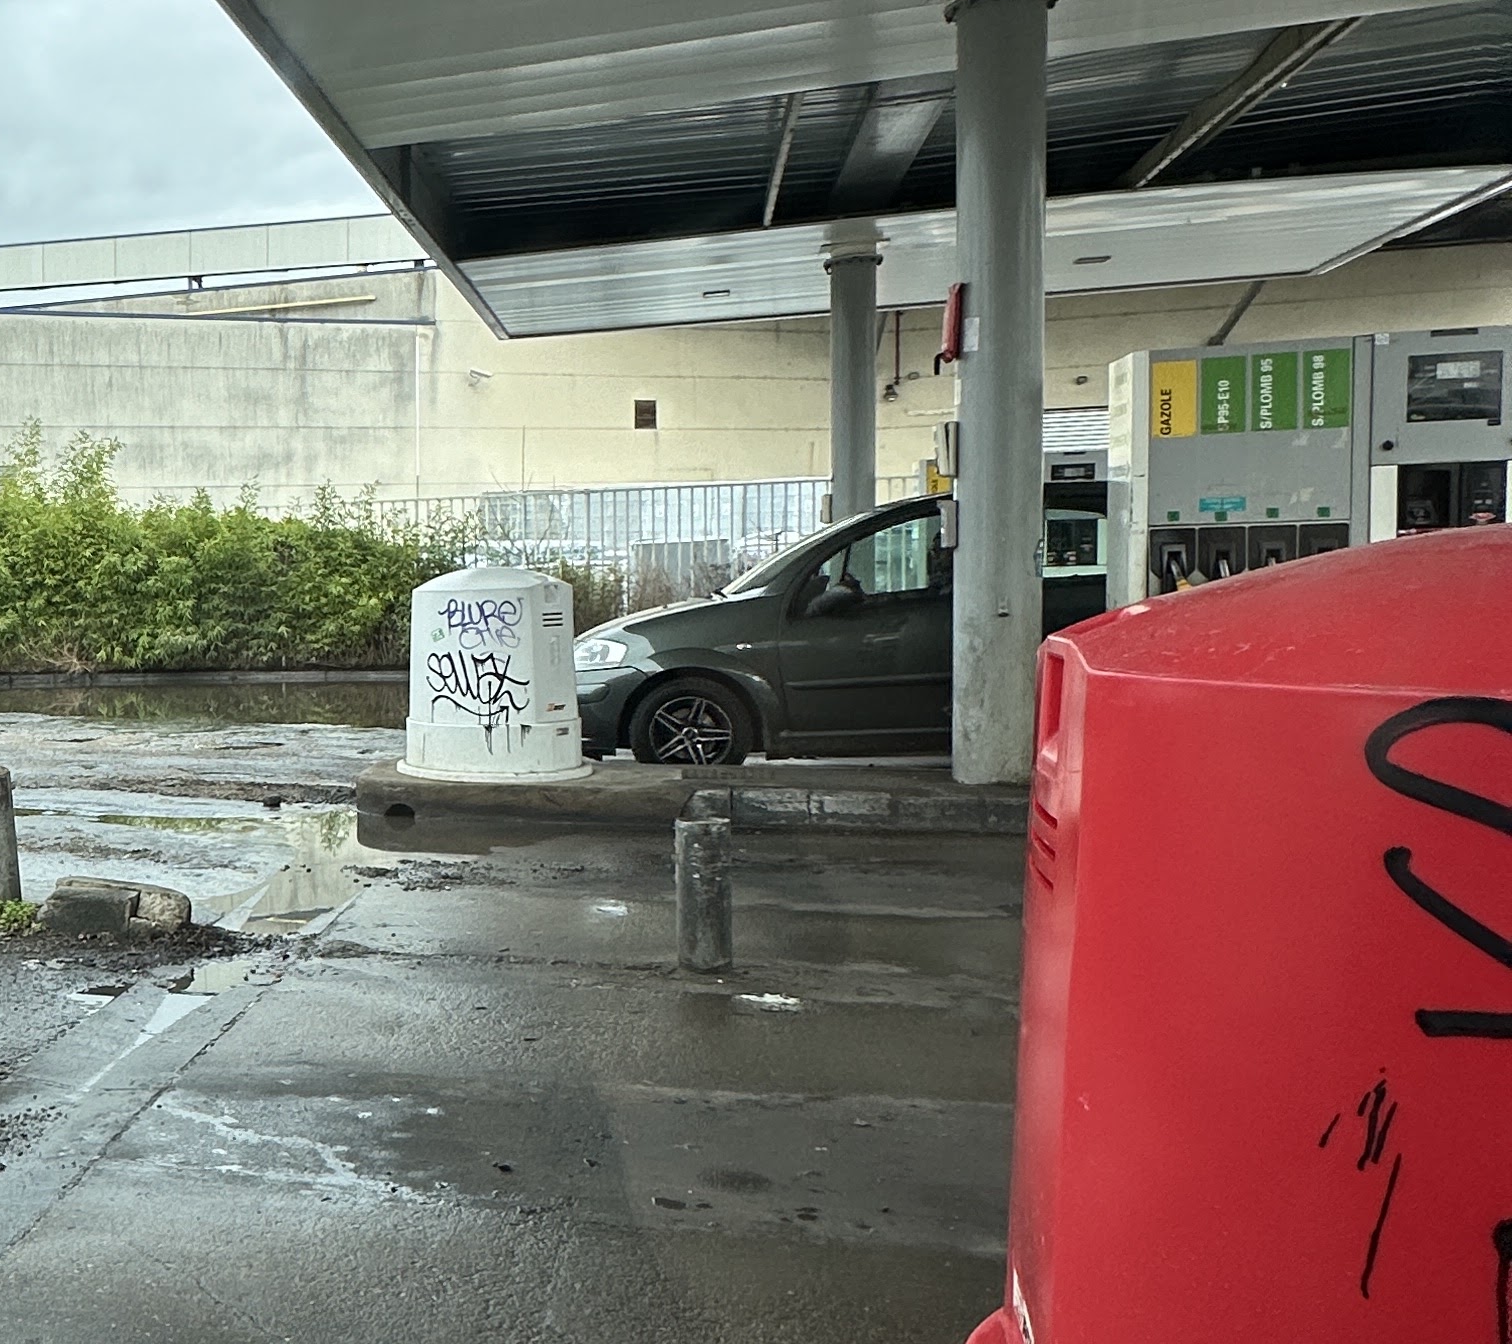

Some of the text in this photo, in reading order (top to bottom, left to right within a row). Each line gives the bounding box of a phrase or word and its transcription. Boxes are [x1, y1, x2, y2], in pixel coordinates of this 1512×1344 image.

[1159, 388, 1172, 436] GAZOLE
[1259, 358, 1273, 429] S/PLOMB 95
